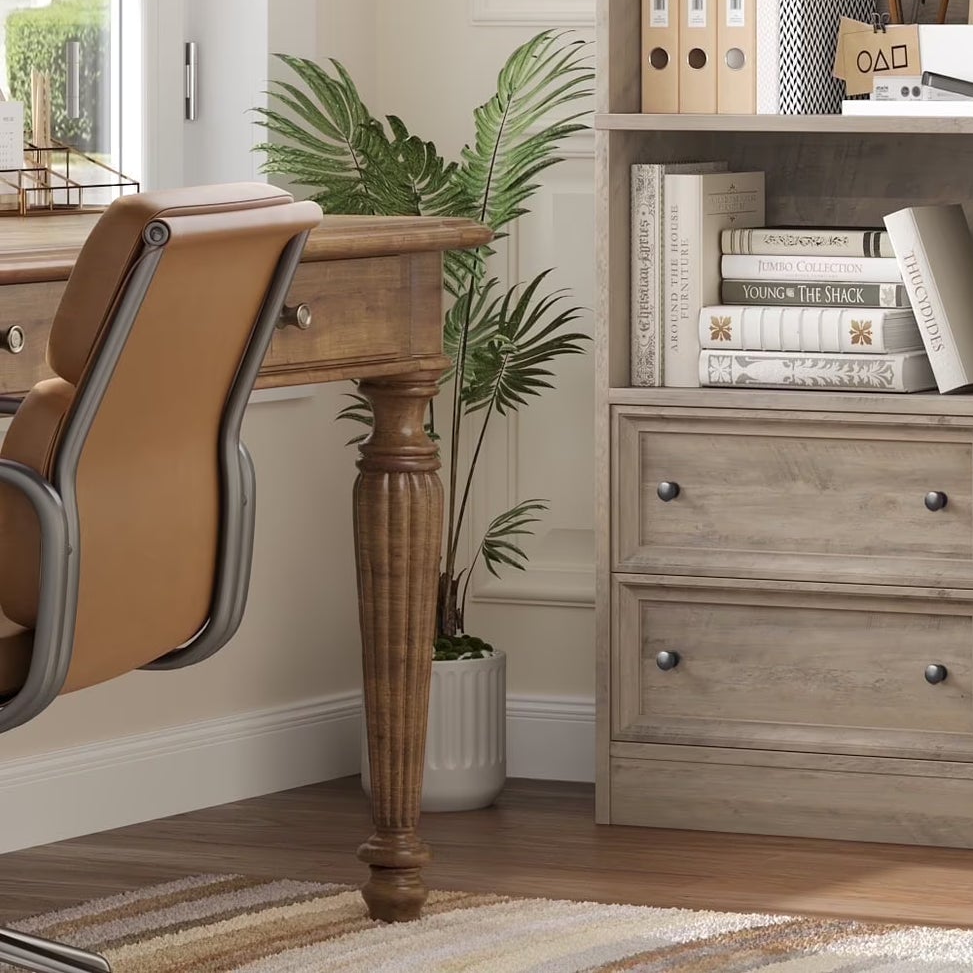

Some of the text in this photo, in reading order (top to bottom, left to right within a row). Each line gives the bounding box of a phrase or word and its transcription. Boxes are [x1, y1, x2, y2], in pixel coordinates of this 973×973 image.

[670, 204, 679, 352] AROUND THE HOUSE
[680, 238, 689, 319] FURNITURE
[742, 284, 865, 303] YOUNG THE SHACK
[758, 259, 863, 274] JUMBO COLLECTION
[903, 250, 945, 352] THUCYDIDES
